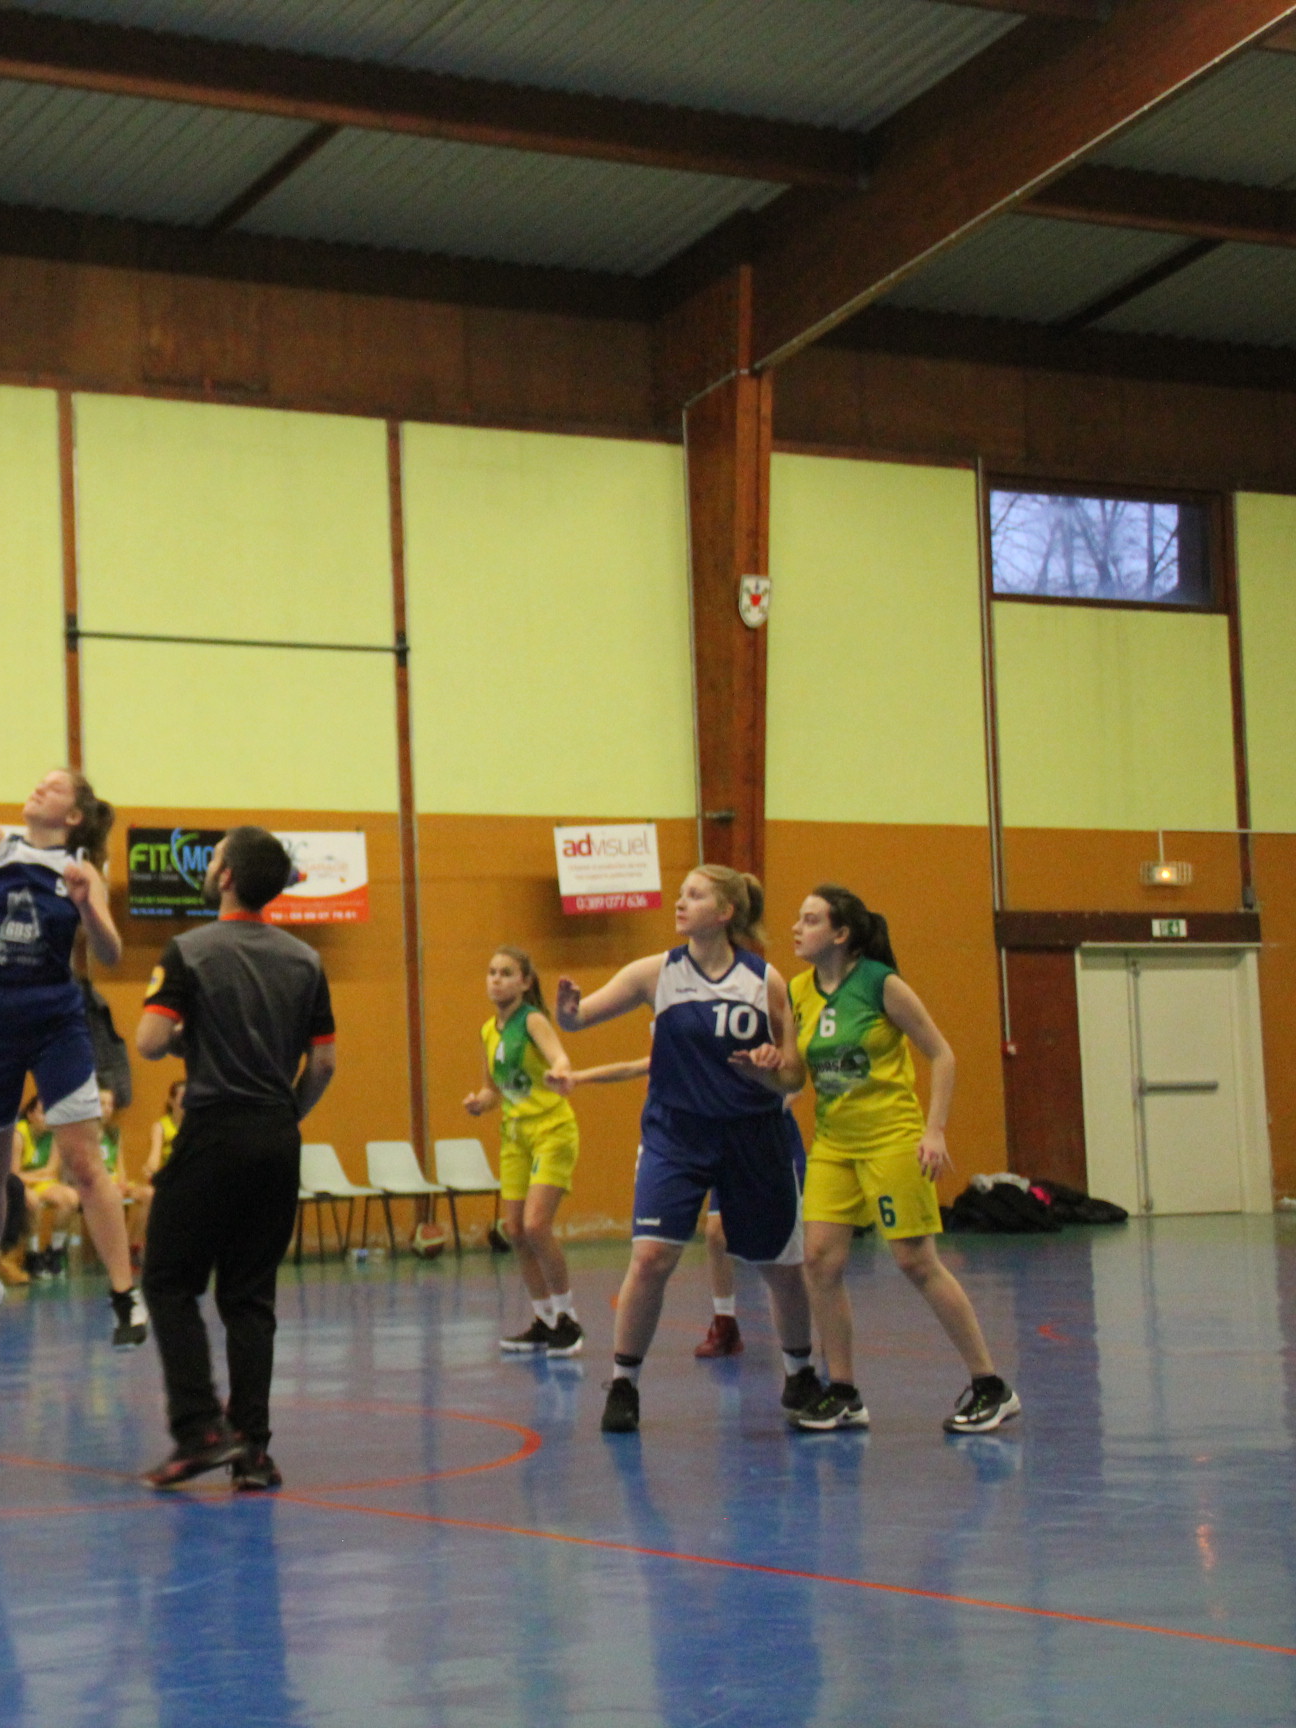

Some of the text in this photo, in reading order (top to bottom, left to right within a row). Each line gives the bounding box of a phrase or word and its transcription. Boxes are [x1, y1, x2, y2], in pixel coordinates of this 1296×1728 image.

[129, 843, 170, 873] FIT
[562, 830, 651, 858] advisuel
[711, 1002, 759, 1041] 10
[819, 1007, 837, 1038] 6
[877, 1194, 897, 1229] 6
